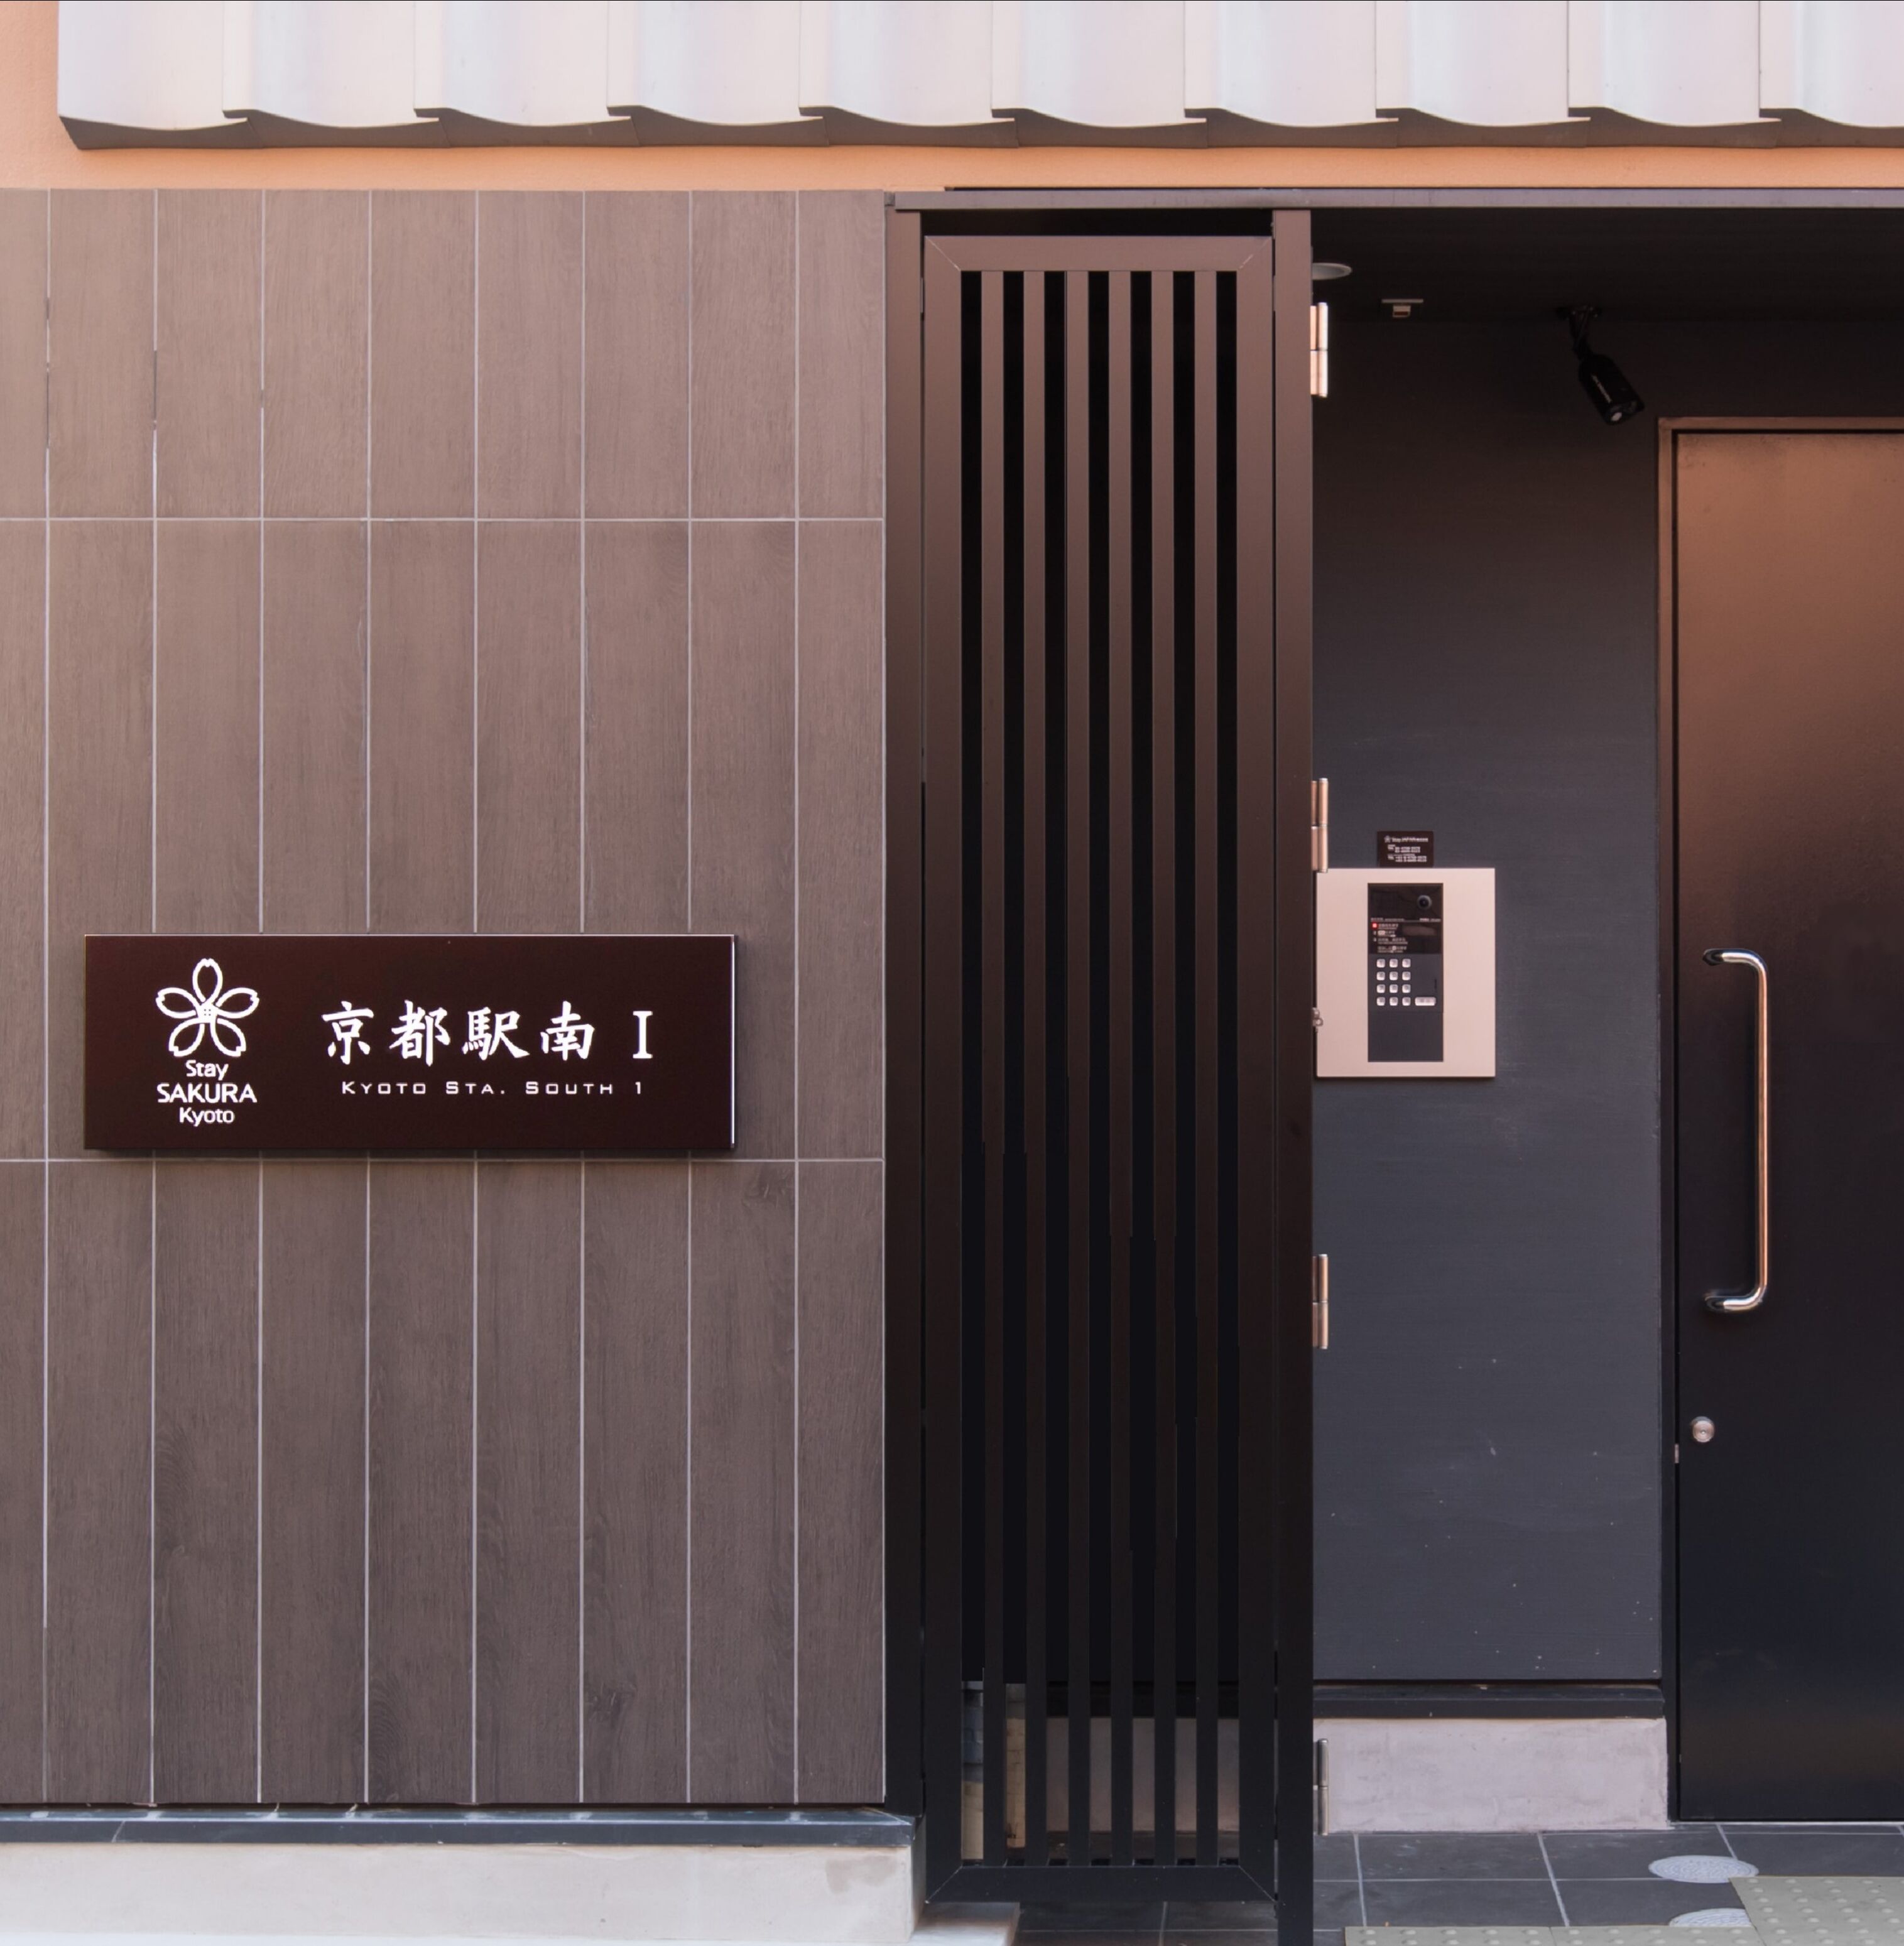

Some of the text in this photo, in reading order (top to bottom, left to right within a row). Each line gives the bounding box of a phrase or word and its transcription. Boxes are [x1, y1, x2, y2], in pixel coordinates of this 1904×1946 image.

[322, 1000, 596, 1067] 京都駅南
[185, 1059, 229, 1081] Stay
[156, 1082, 258, 1104] SAKURA
[635, 1082, 641, 1094] 1
[179, 1107, 235, 1127] Kyoto
